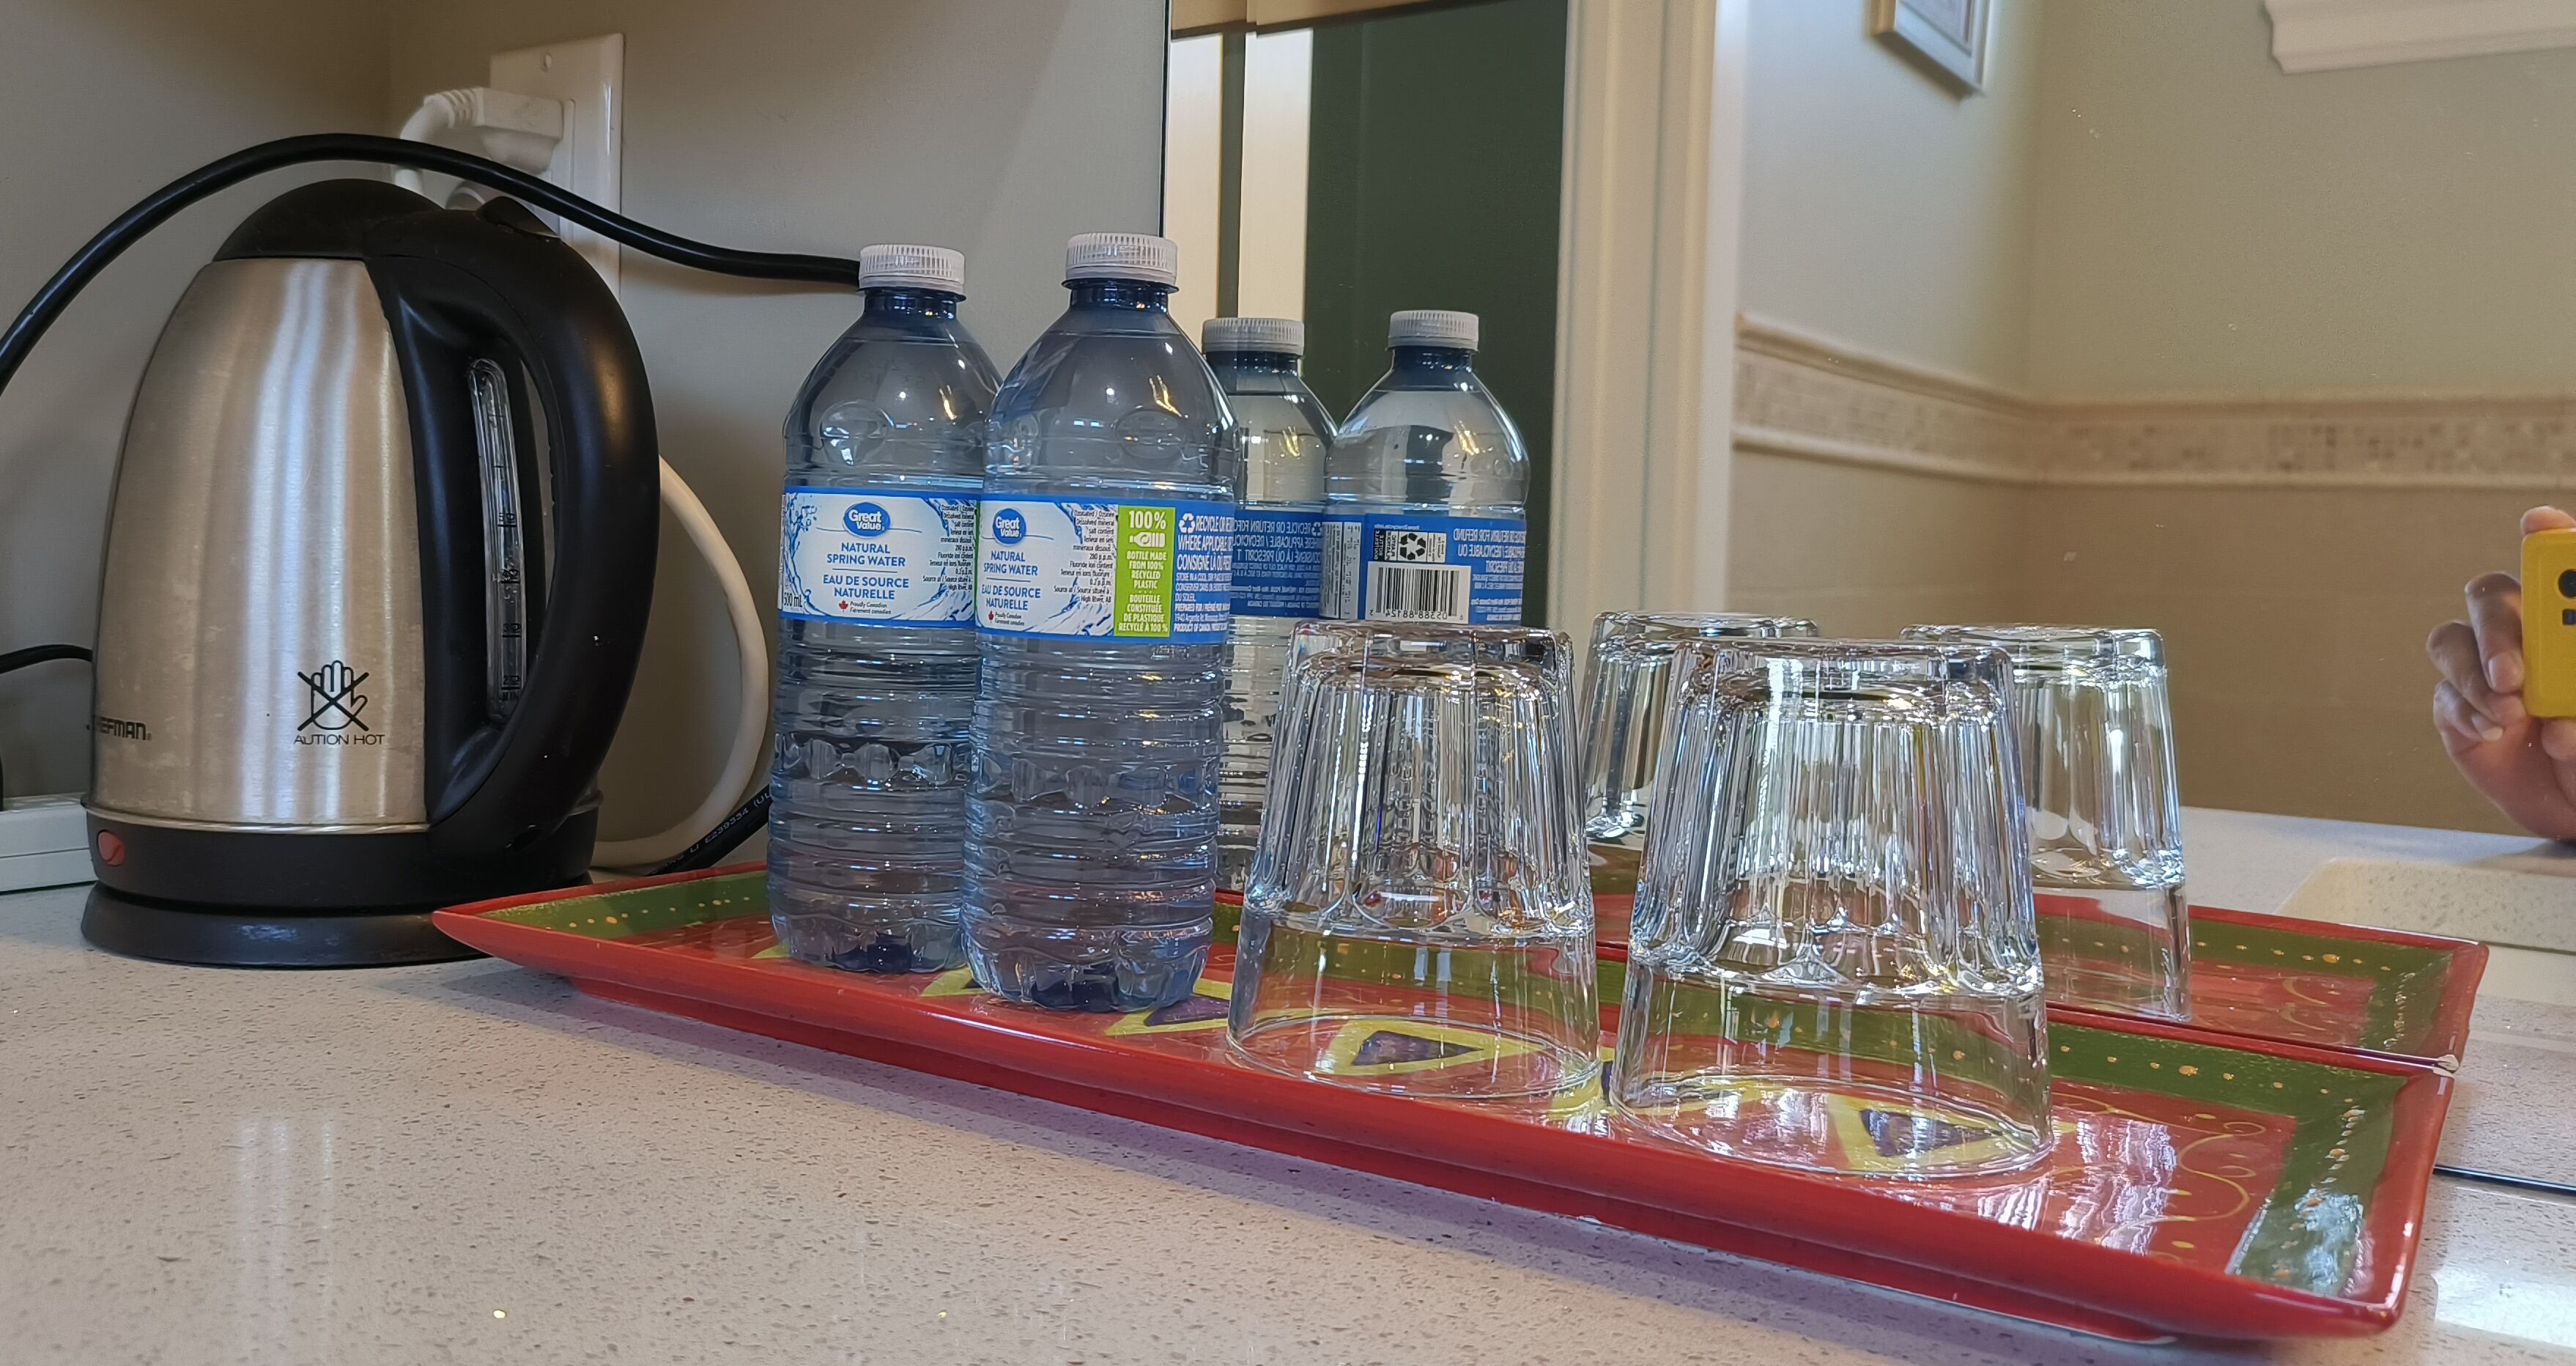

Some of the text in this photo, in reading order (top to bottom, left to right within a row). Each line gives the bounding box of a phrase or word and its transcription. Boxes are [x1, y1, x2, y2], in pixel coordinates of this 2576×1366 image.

[848, 509, 882, 523] Great
[1129, 510, 1166, 530] 100%
[856, 521, 881, 531] Value
[995, 516, 1020, 529] Great
[1196, 516, 1219, 532] RECYCLE
[1000, 528, 1019, 538] Value
[841, 542, 891, 554] NATURAL
[1178, 535, 1202, 550] WHERE
[826, 553, 906, 566] SPRING WATER
[991, 551, 1025, 562] NATURAL
[1127, 551, 1167, 561] BOTTLE MADE
[1177, 551, 1210, 571] CONSIGNÉ
[983, 562, 1038, 576] SPRING WATER
[1129, 561, 1164, 570] FROM 100%
[1131, 570, 1161, 579] RECYCLED
[823, 575, 909, 588] EAU DE SOURCE
[1134, 580, 1158, 589] PLASTIC
[834, 588, 895, 599] NATURELLE
[981, 584, 1041, 598] EAU DE SOURCE
[986, 598, 1028, 610] NATURELLE
[1129, 594, 1161, 603] BOUTEILLE
[1127, 603, 1162, 613] CONSTITUÉE
[1124, 613, 1165, 623] DE PLASTIQUE
[1118, 621, 1144, 631] RECYCLÉ
[98, 715, 147, 741] EFMAN
[293, 734, 385, 745] AUTION HOT
[704, 808, 749, 843] E239334
